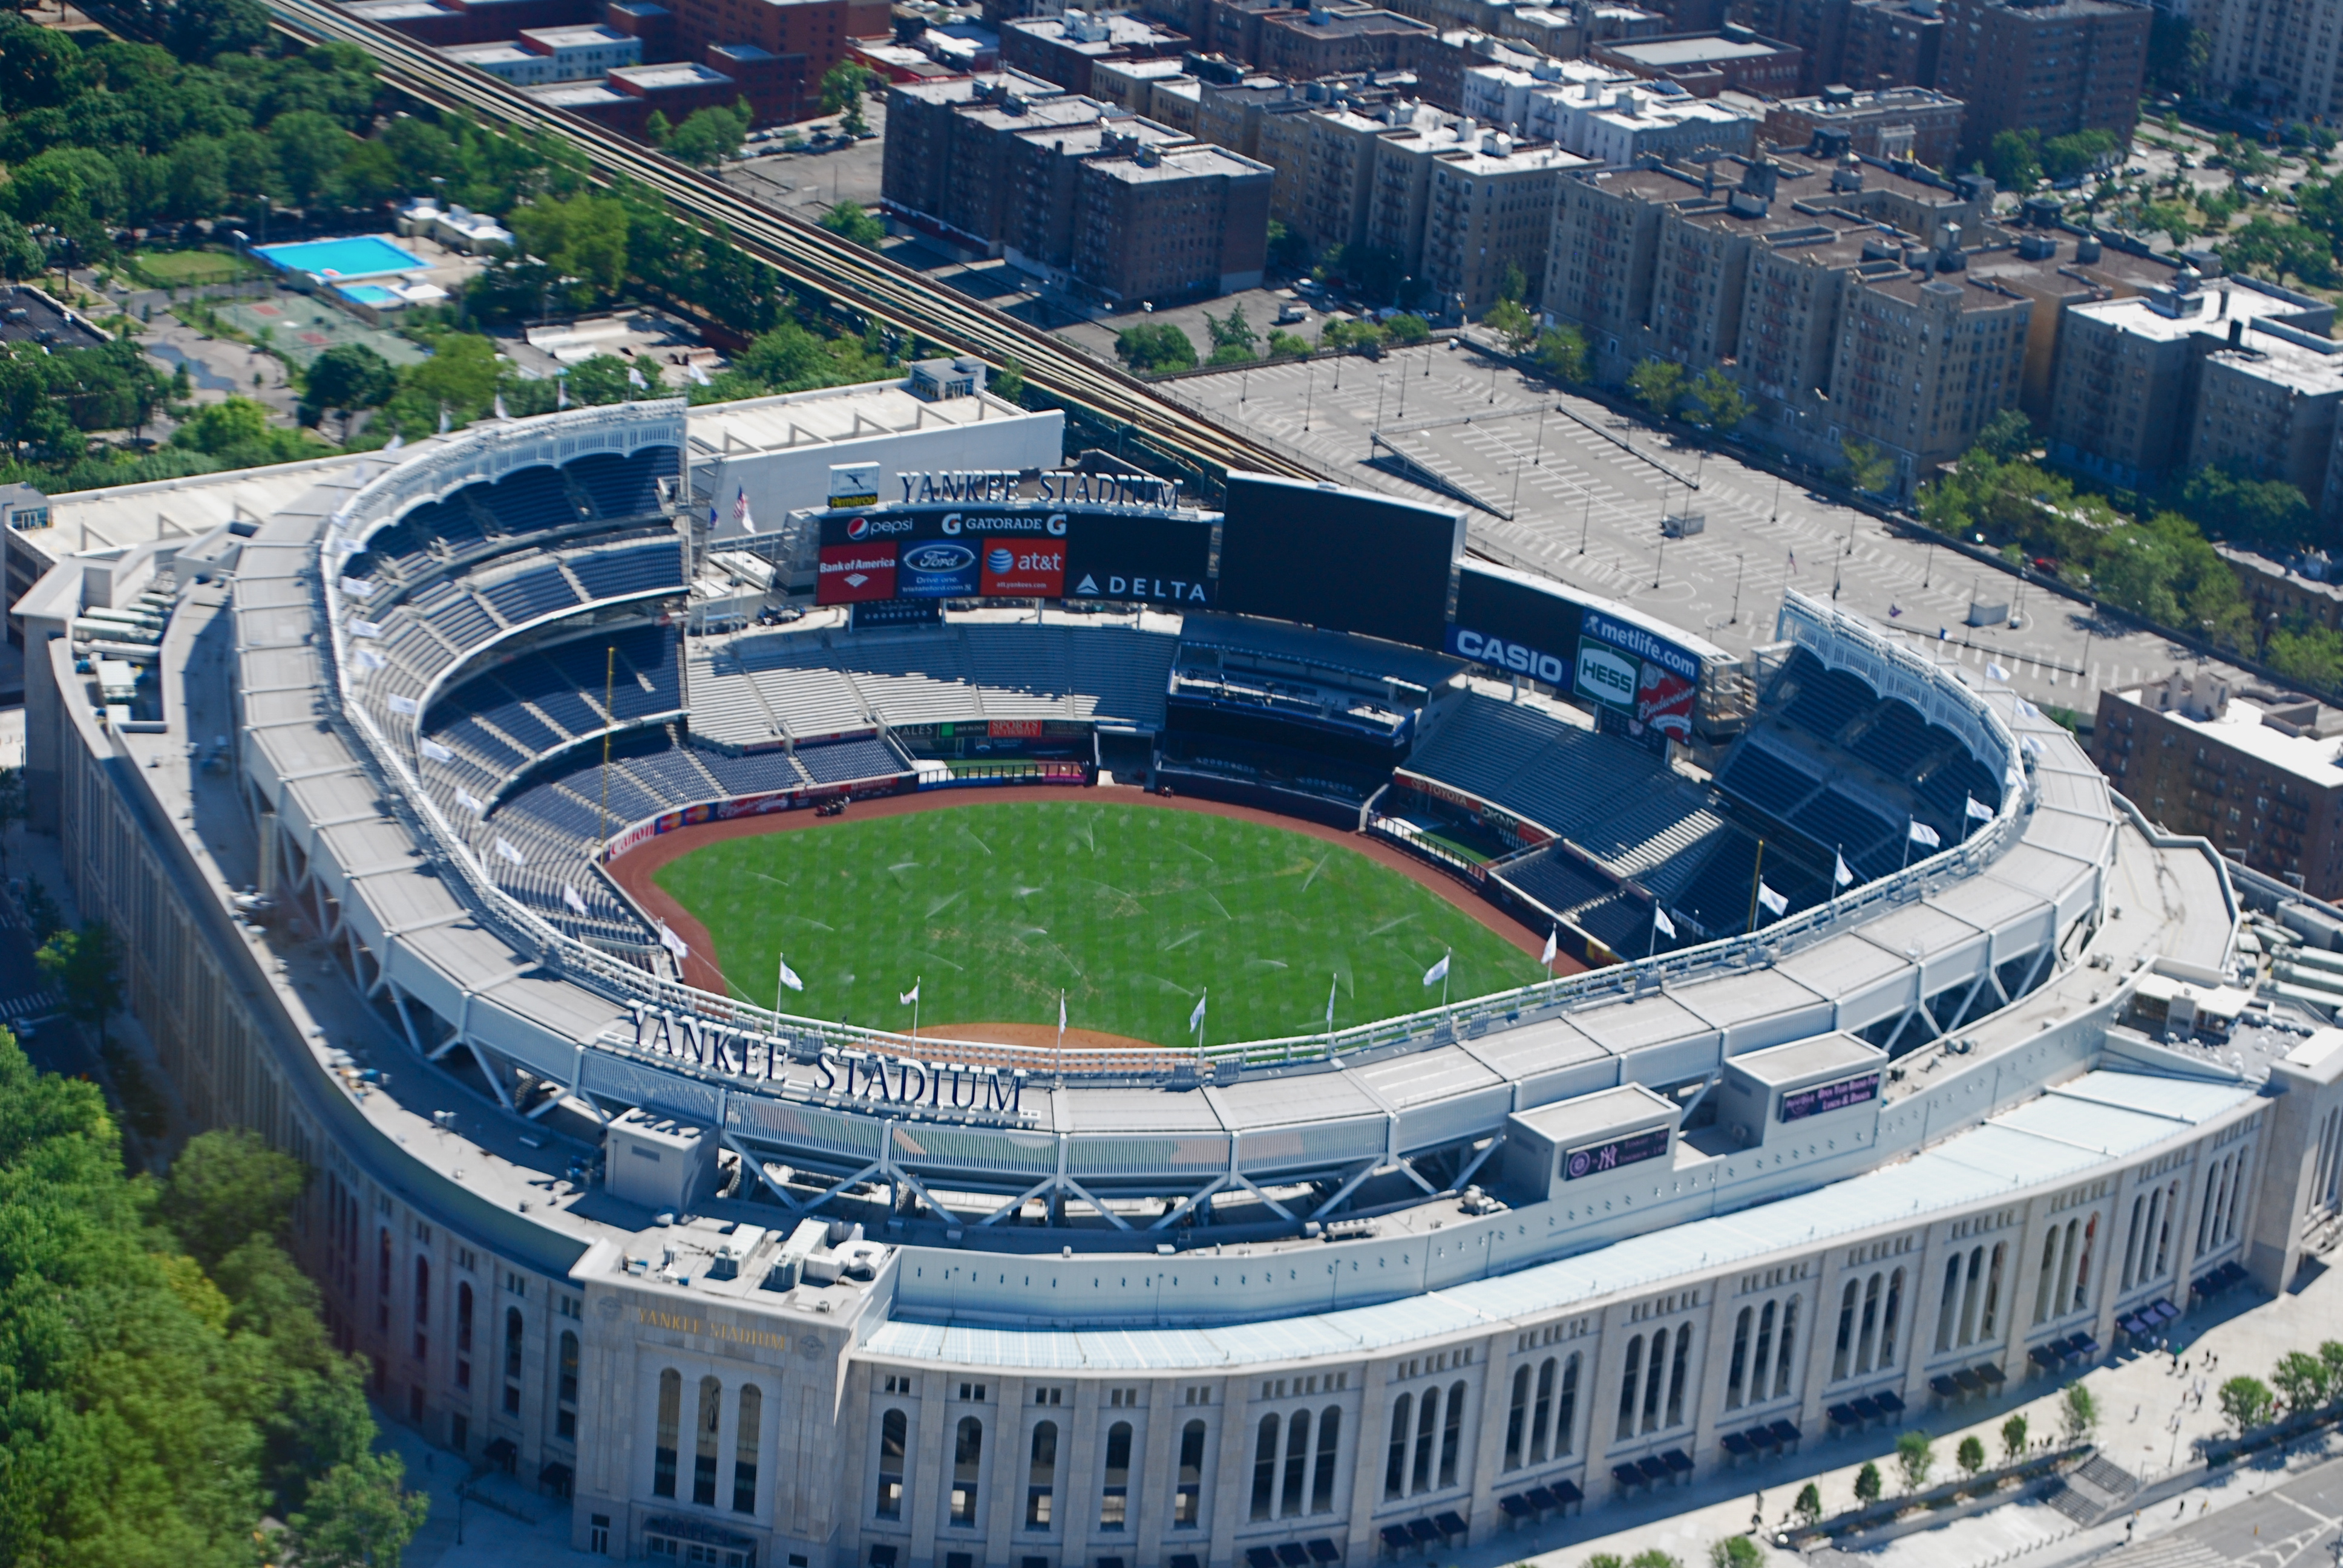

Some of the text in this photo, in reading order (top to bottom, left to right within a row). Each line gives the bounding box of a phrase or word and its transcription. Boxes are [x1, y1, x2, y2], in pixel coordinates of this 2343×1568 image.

[896, 469, 1184, 509] YANKEE STADIUM
[870, 518, 913, 535] pepsi
[966, 518, 1042, 529] GATORADE
[820, 557, 896, 573] Bank of America
[920, 550, 958, 567] Ford
[1018, 552, 1061, 570] at&t
[1109, 576, 1206, 602] DELTA
[1457, 630, 1562, 682] CASIO
[1601, 620, 1694, 676] metlife.com
[1582, 659, 1633, 693] HESS
[1638, 685, 1696, 720] Budweiser
[993, 720, 1038, 729] SPORTS
[1427, 782, 1467, 806] TOYOTA
[1483, 806, 1518, 828] DKNY
[611, 823, 654, 855] Canon
[626, 998, 1027, 1112] YANKEE STADIUM
[638, 1307, 785, 1351] YANKEE STADIUM
